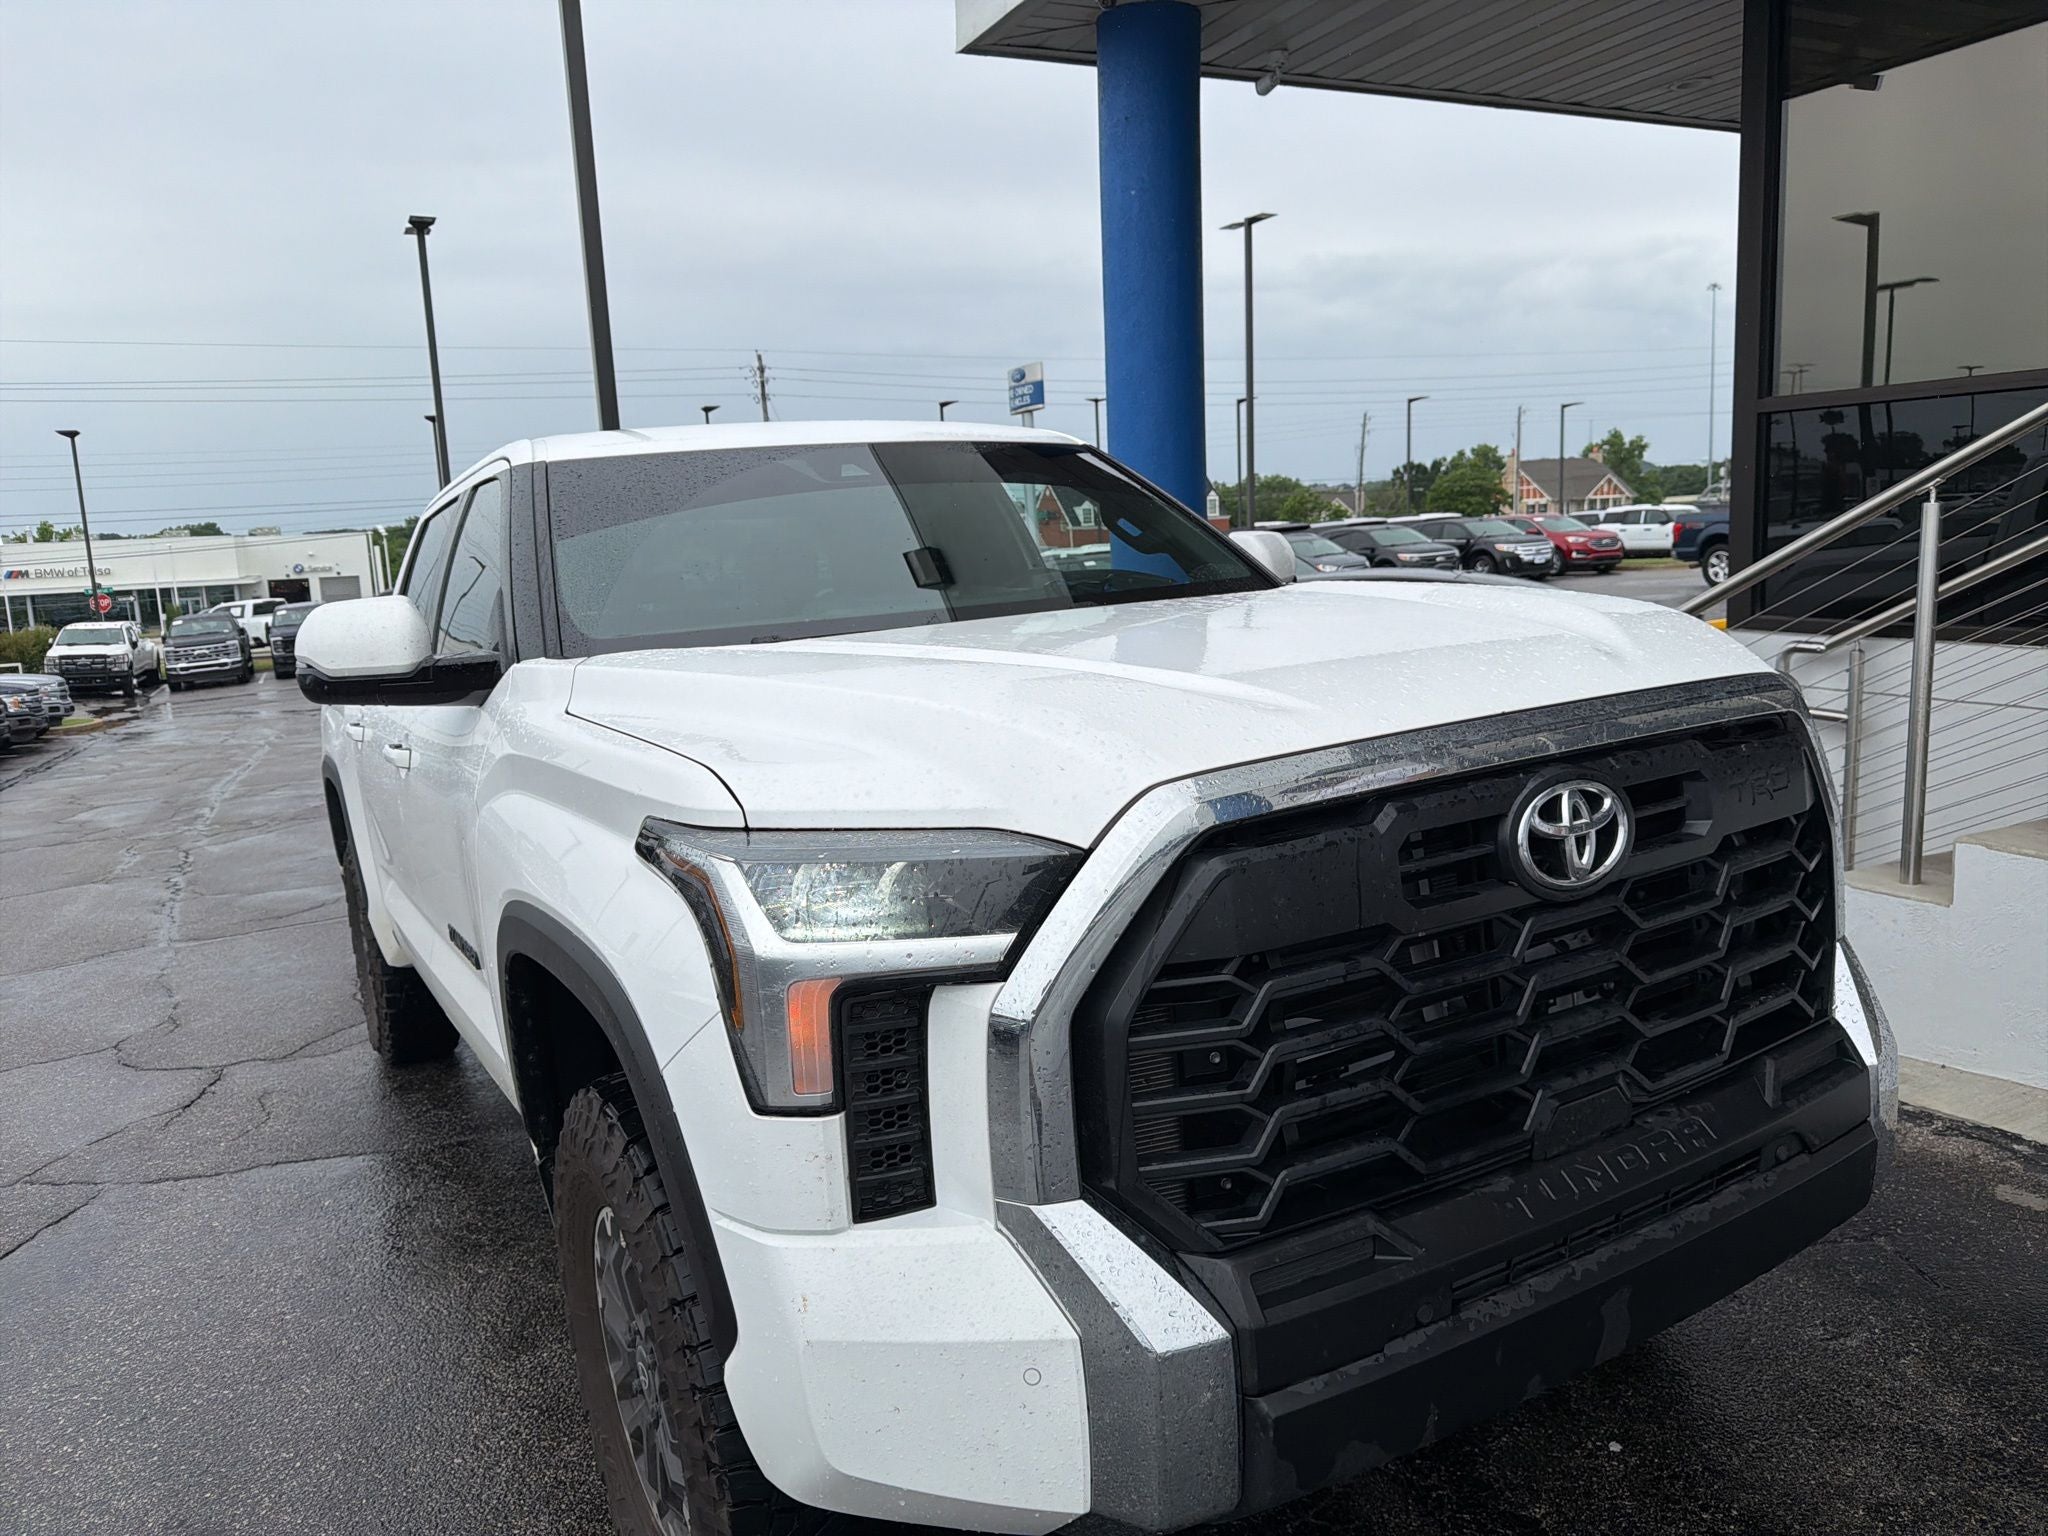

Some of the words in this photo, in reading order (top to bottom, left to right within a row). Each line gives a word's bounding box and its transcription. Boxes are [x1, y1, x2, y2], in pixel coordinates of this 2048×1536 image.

[34, 567, 66, 579] BMW
[67, 567, 79, 576] of
[80, 566, 111, 576] Tlsa
[91, 598, 110, 608] SOP
[1729, 761, 1791, 806] TRD
[1510, 1115, 1719, 1220] TUNDRA
